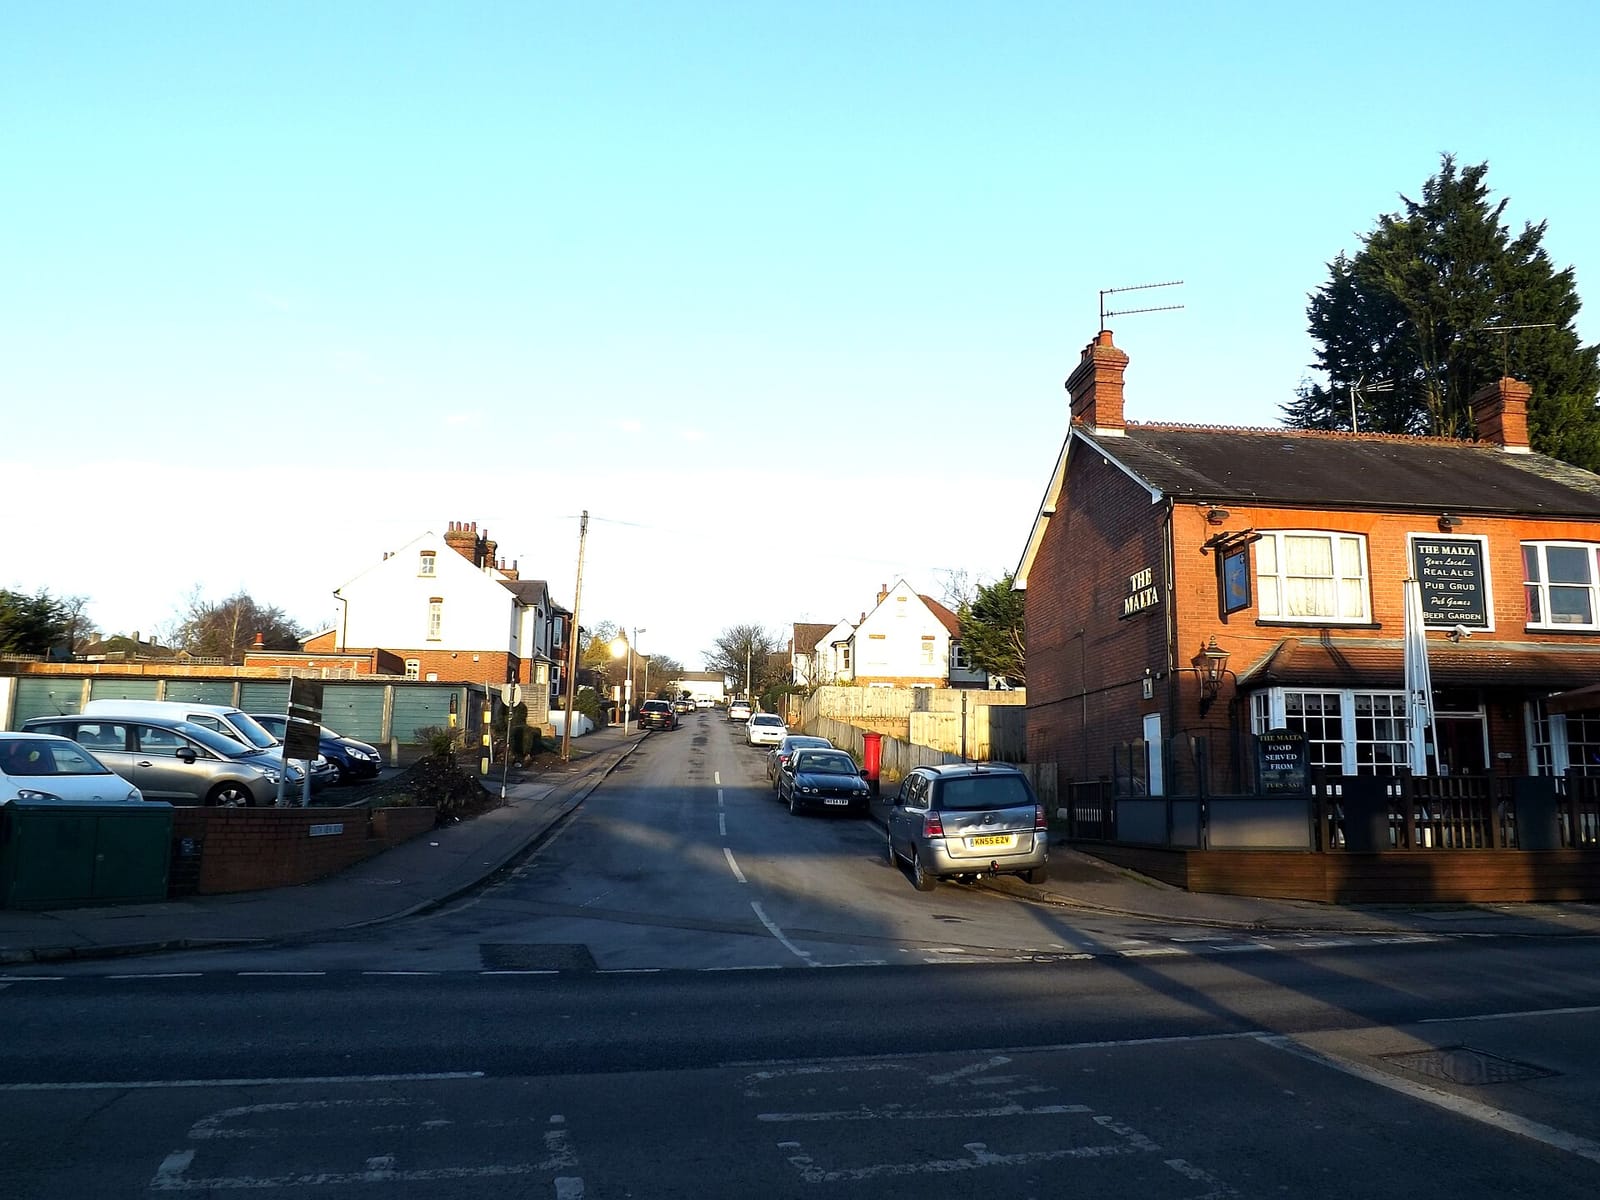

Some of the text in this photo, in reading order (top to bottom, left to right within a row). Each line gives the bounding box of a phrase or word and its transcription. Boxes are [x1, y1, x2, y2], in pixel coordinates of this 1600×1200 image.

[1418, 545, 1476, 556] THE MALTA
[1424, 556, 1472, 567] Your Local
[1423, 567, 1475, 577] REAL ALES
[1130, 567, 1152, 592] THE
[1424, 581, 1476, 591] PUB GRUB
[1124, 586, 1160, 615] MALTA
[1430, 596, 1471, 608] Pub Games
[1423, 611, 1481, 620] BEER GARDEN
[1265, 753, 1298, 761] SERVED
